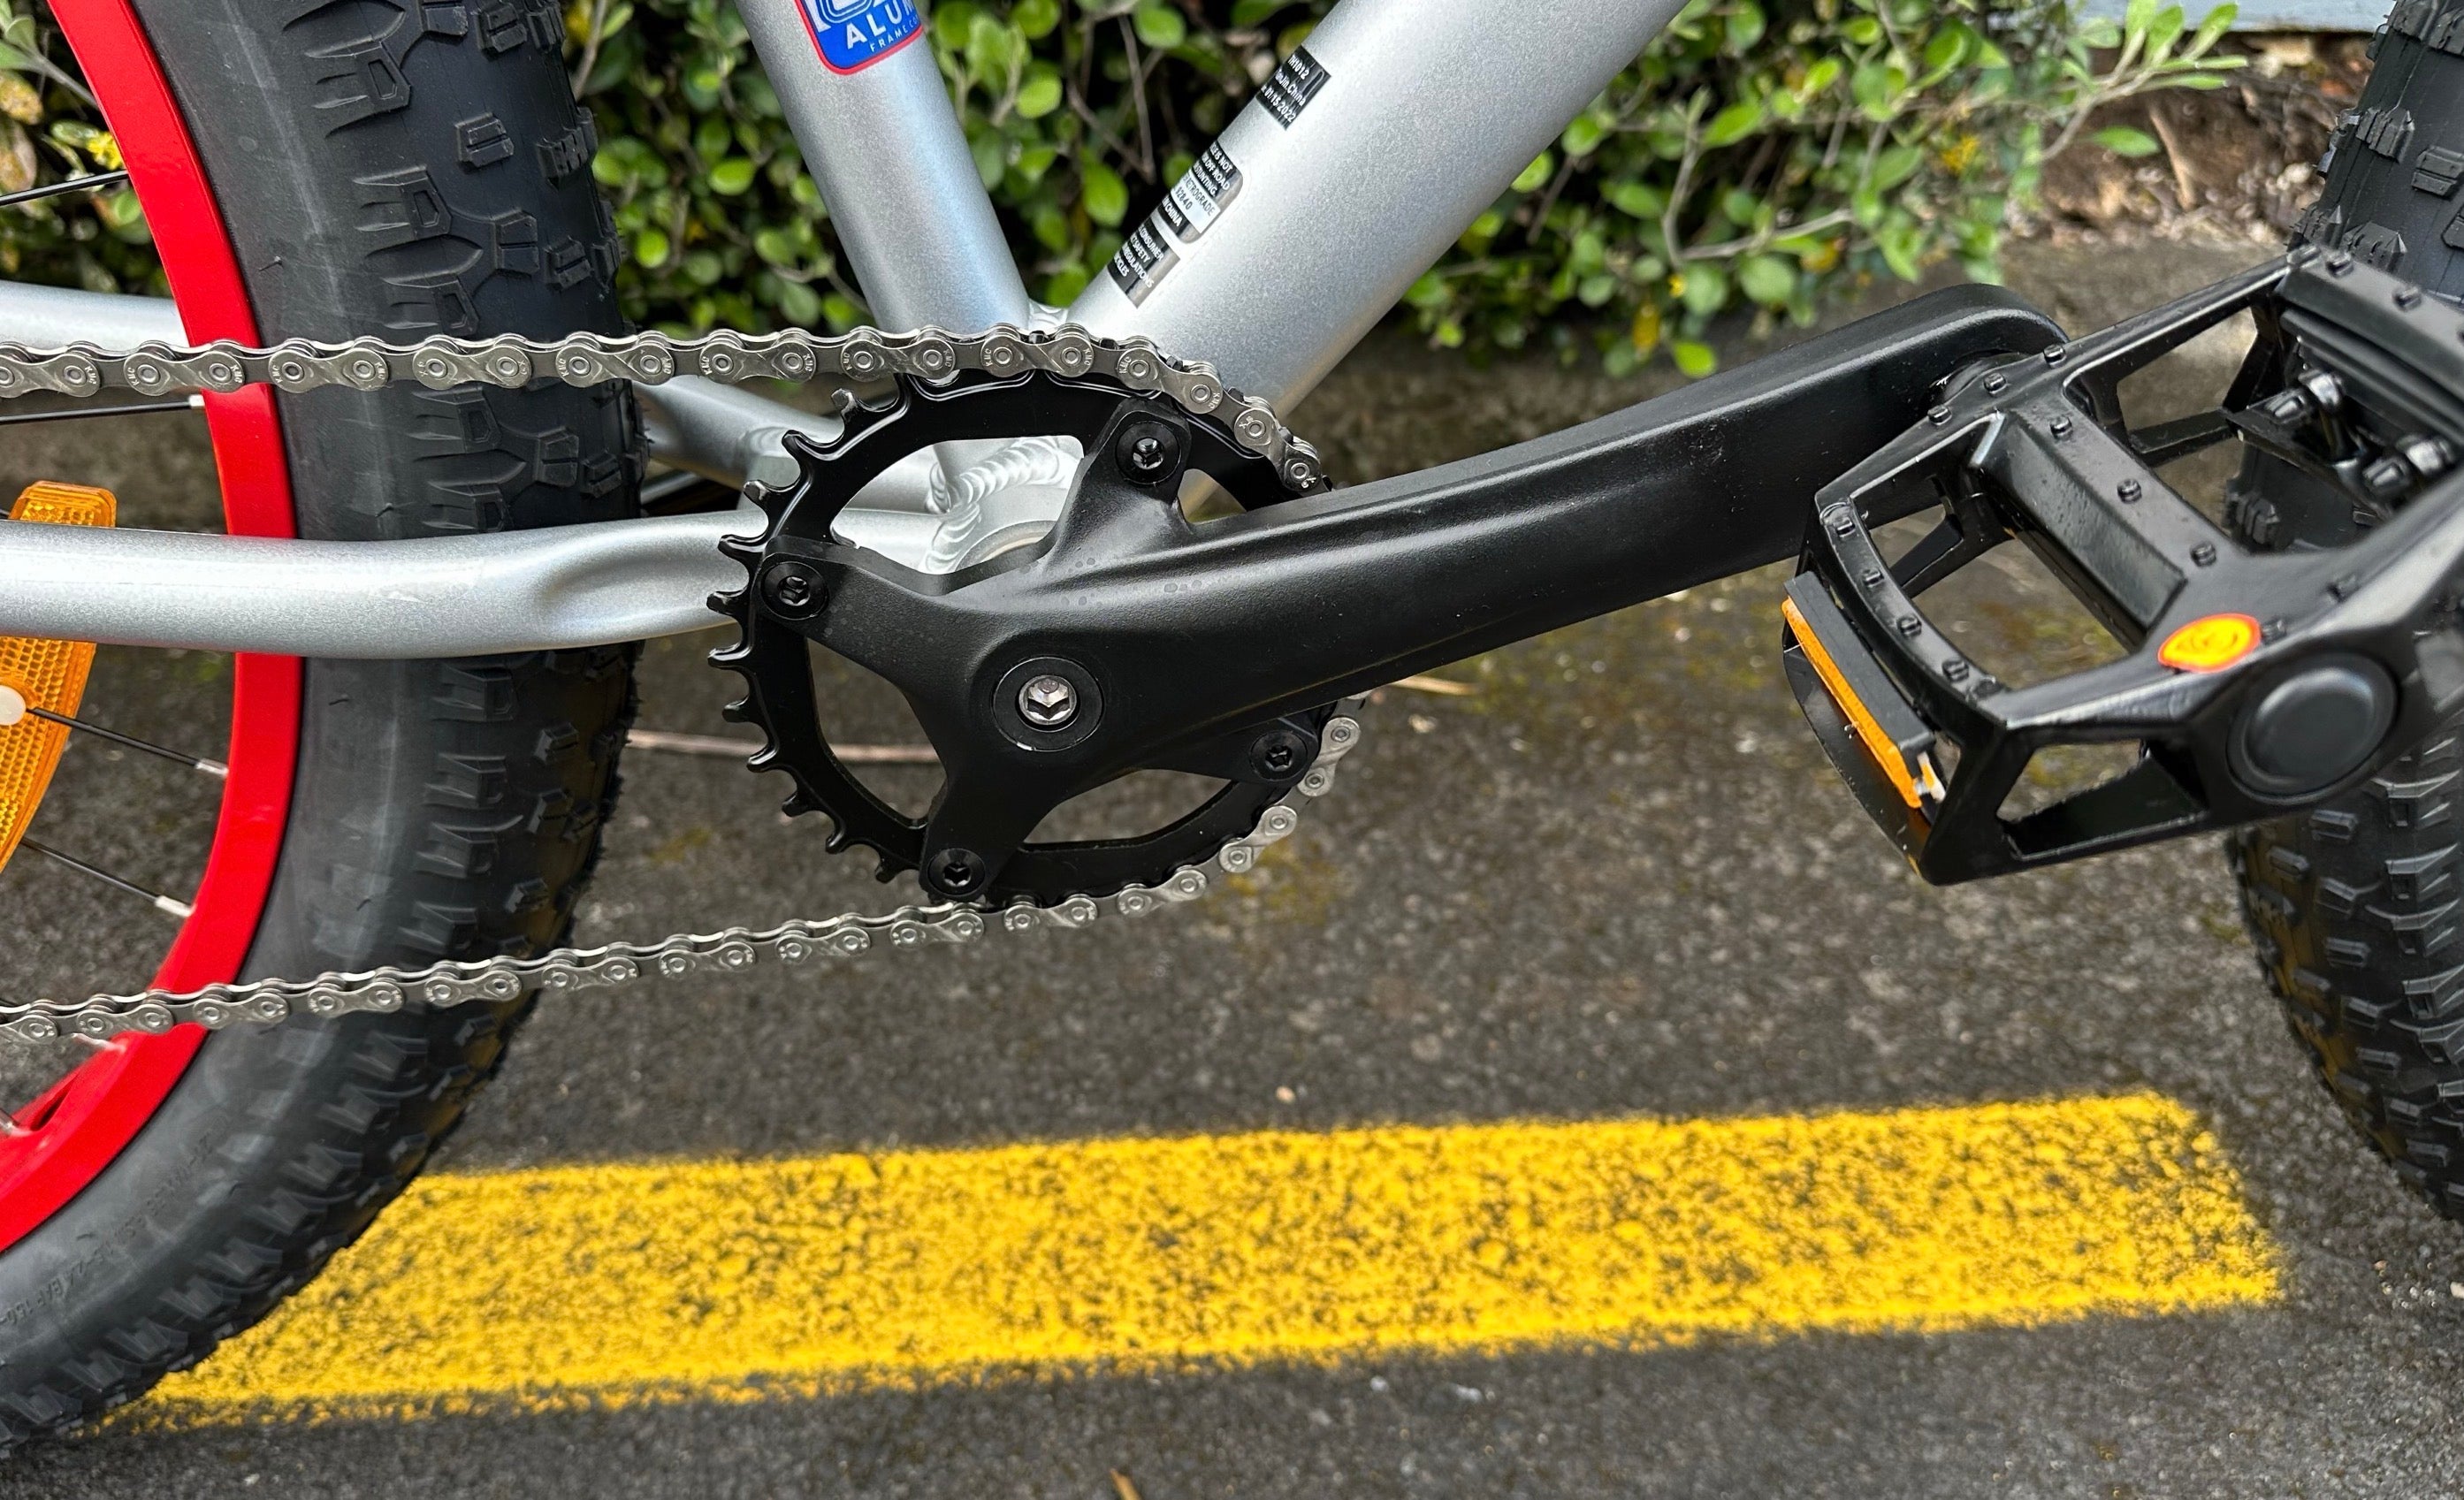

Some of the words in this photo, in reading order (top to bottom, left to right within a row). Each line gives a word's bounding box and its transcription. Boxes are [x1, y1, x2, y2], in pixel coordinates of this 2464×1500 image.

[869, 25, 908, 52] FRAME
[1204, 158, 1217, 172] OFF
[1211, 168, 1231, 191] ROAD
[1217, 156, 1233, 173] NOT
[1163, 202, 1184, 226] CHINA
[1132, 240, 1150, 263] SAFETY
[1138, 227, 1164, 262] CONSUMER
